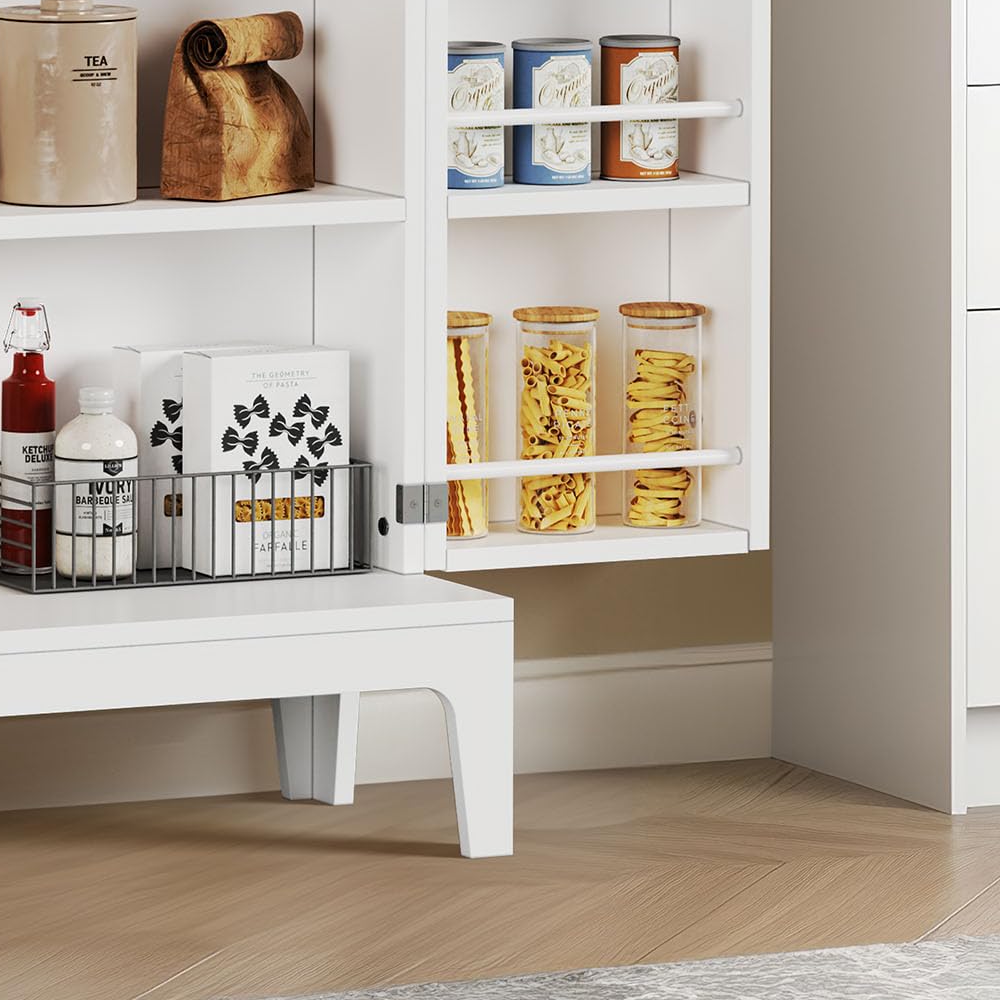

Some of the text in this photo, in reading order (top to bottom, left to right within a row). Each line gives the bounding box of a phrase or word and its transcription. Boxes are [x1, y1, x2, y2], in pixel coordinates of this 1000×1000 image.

[84, 55, 108, 67] TEA
[268, 370, 310, 379] GEOMETRY
[89, 480, 132, 495] IVORY
